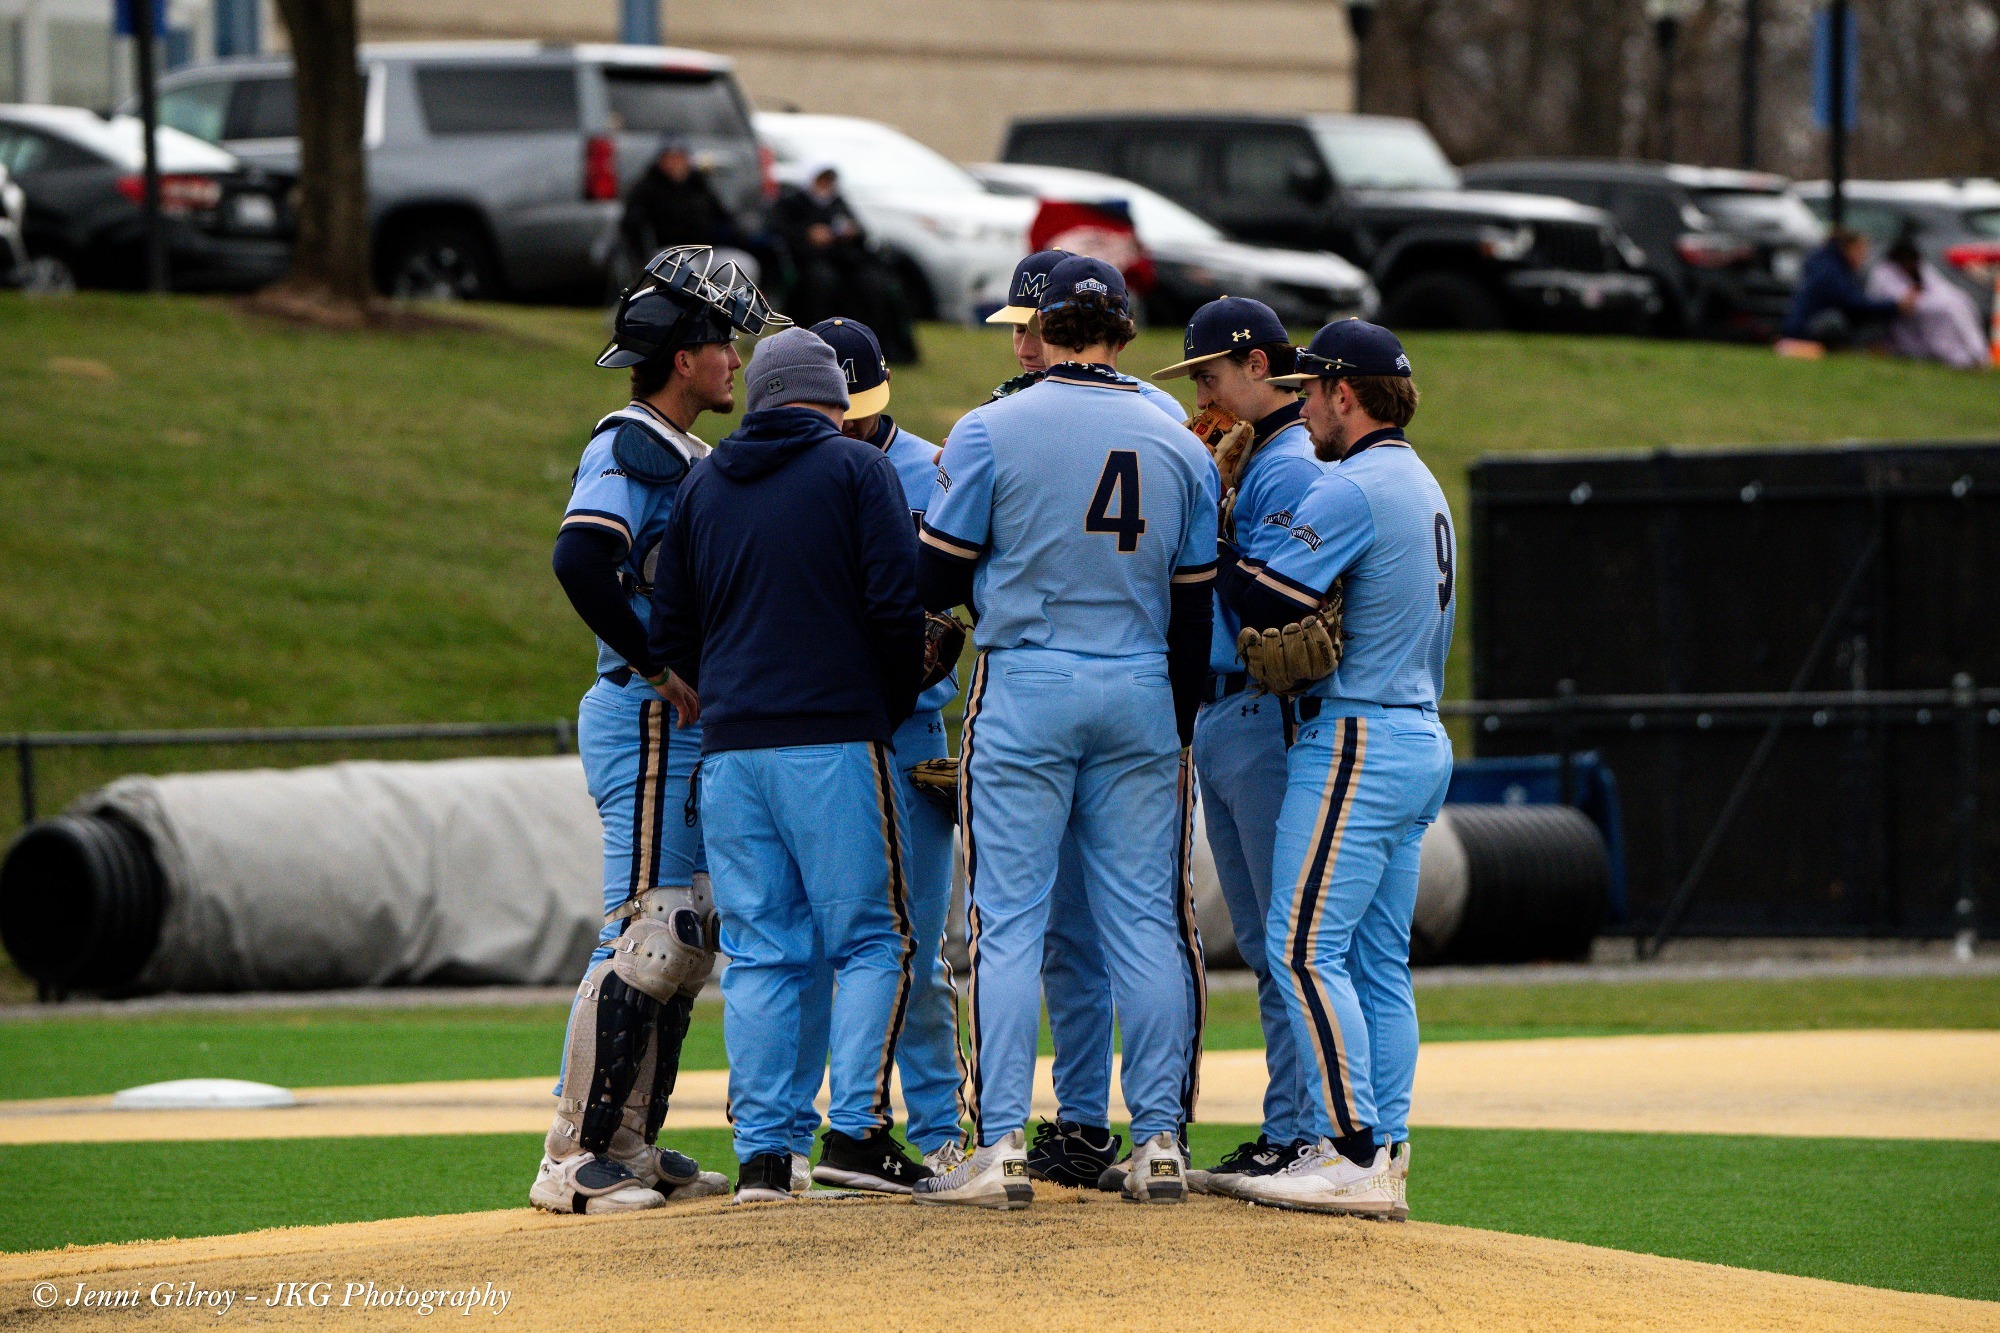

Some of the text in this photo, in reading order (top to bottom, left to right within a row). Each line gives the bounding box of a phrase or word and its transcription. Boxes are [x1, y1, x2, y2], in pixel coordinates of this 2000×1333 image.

[1017, 272, 1046, 297] M
[600, 468, 627, 478] MAA
[1085, 450, 1145, 553] 4
[1300, 529, 1322, 549] MOUNT
[1434, 511, 1453, 612] 9
